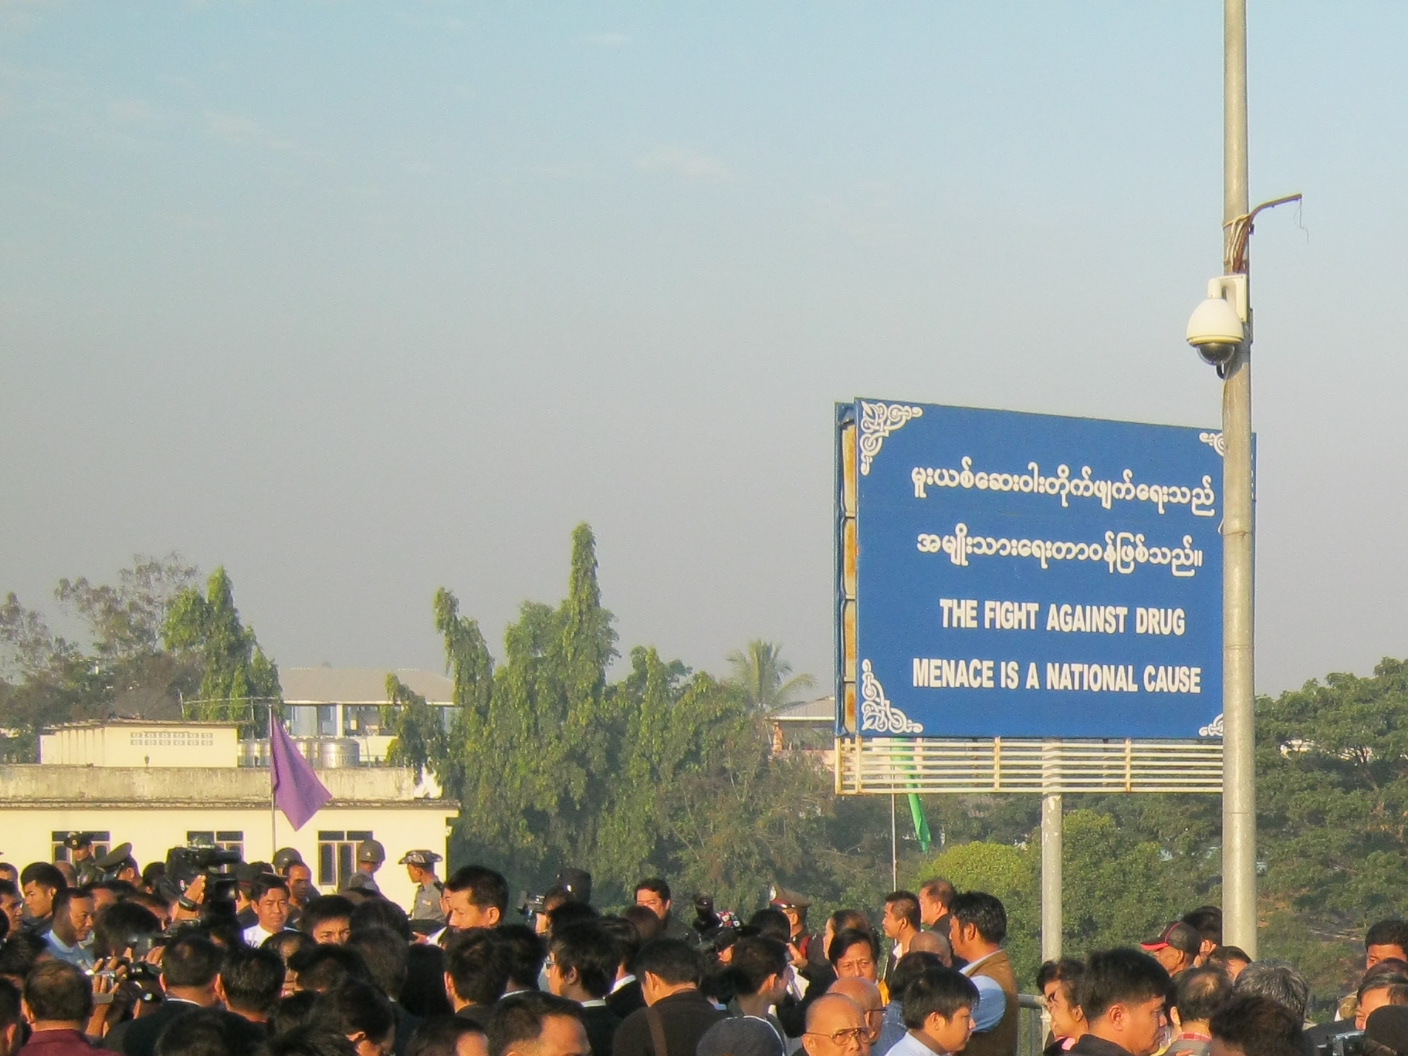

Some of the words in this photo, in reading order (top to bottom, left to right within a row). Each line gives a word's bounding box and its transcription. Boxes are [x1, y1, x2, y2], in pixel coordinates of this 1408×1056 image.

[940, 599, 978, 629] THE
[984, 600, 1040, 630] FIGHT
[1046, 604, 1129, 634] AGAINST
[1135, 606, 1186, 637] DRUG
[912, 658, 995, 689] MENACE
[1000, 660, 1020, 689] IS
[1025, 661, 1040, 690] A
[1046, 662, 1138, 692] NATIONAL
[1143, 665, 1202, 694] CAUSE
